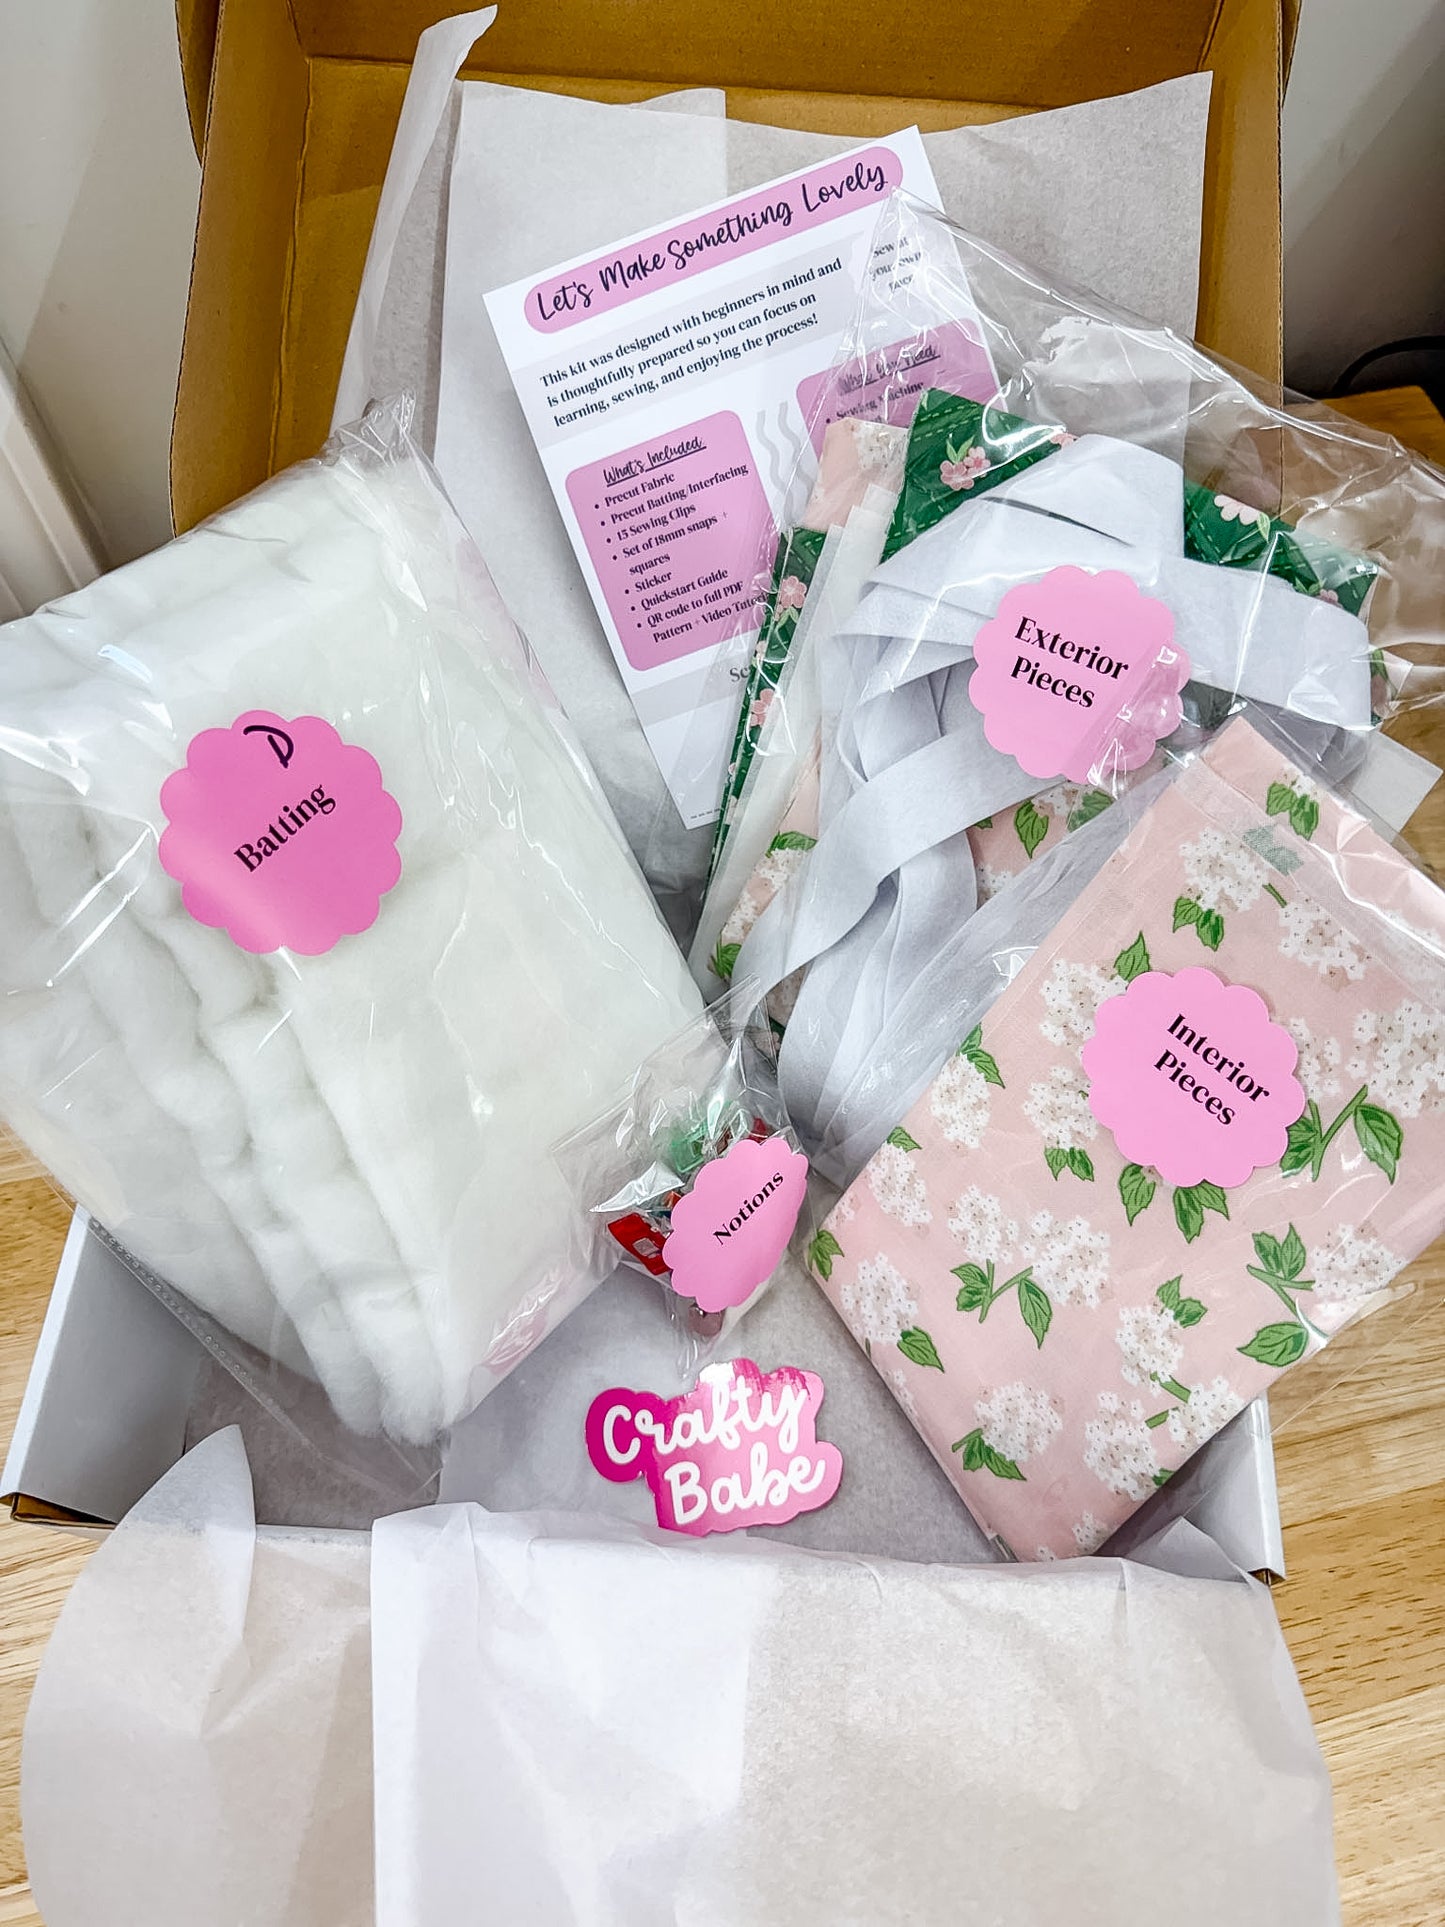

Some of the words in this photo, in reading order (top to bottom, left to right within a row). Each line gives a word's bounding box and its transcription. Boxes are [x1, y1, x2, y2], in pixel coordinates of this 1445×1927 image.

[537, 281, 593, 320] Let's
[599, 253, 666, 292] Make
[667, 201, 793, 270] Something
[801, 162, 888, 212] Lovely
[540, 372, 568, 388] This
[569, 361, 587, 376] kit
[589, 351, 614, 368] was
[615, 326, 671, 359] designed
[672, 315, 701, 336] with
[702, 291, 765, 323] beginners
[766, 284, 781, 298] in
[782, 268, 816, 291] mind
[817, 257, 842, 278] and
[546, 396, 559, 408] is
[560, 364, 635, 403] thoughtfully
[637, 340, 695, 375] prepared
[696, 335, 711, 348] so
[712, 324, 737, 344] you
[738, 315, 762, 331] can
[763, 300, 798, 321] focus
[799, 293, 817, 307] on
[554, 400, 610, 427] learning,
[611, 378, 659, 405] sewing,
[660, 365, 685, 385] and
[686, 346, 741, 374] enjoying
[742, 336, 763, 352] the
[764, 313, 819, 347] process!
[603, 458, 646, 485] What's
[646, 436, 702, 468] Included
[604, 486, 640, 508] Precut
[641, 473, 676, 493] Fabric
[610, 504, 646, 524] Precut
[617, 529, 629, 541] 15
[629, 516, 669, 536] Sewing
[668, 504, 697, 520] Clips
[622, 544, 641, 558] Set
[642, 538, 653, 551] of
[654, 528, 686, 546] 18mm
[686, 515, 718, 534] snaps
[629, 553, 671, 576] squares
[635, 571, 672, 593] Sticker
[641, 581, 696, 611] Quickstart
[697, 569, 728, 588] Guide
[647, 612, 664, 628] QR
[664, 603, 690, 621] code
[691, 597, 704, 610] to
[703, 590, 722, 606] full
[724, 580, 744, 597] PDF
[652, 621, 693, 643] Pattern
[701, 606, 732, 624] Video
[732, 592, 769, 612] Tutori
[1014, 615, 1129, 680] Exterior
[1010, 655, 1095, 709] Pieces
[233, 784, 336, 873] Batting
[1153, 1049, 1236, 1126] Pieces
[1167, 1013, 1270, 1103] Interior
[712, 1171, 784, 1246] Notions
[603, 1375, 808, 1466] Crafty
[664, 1441, 826, 1526] Babe
